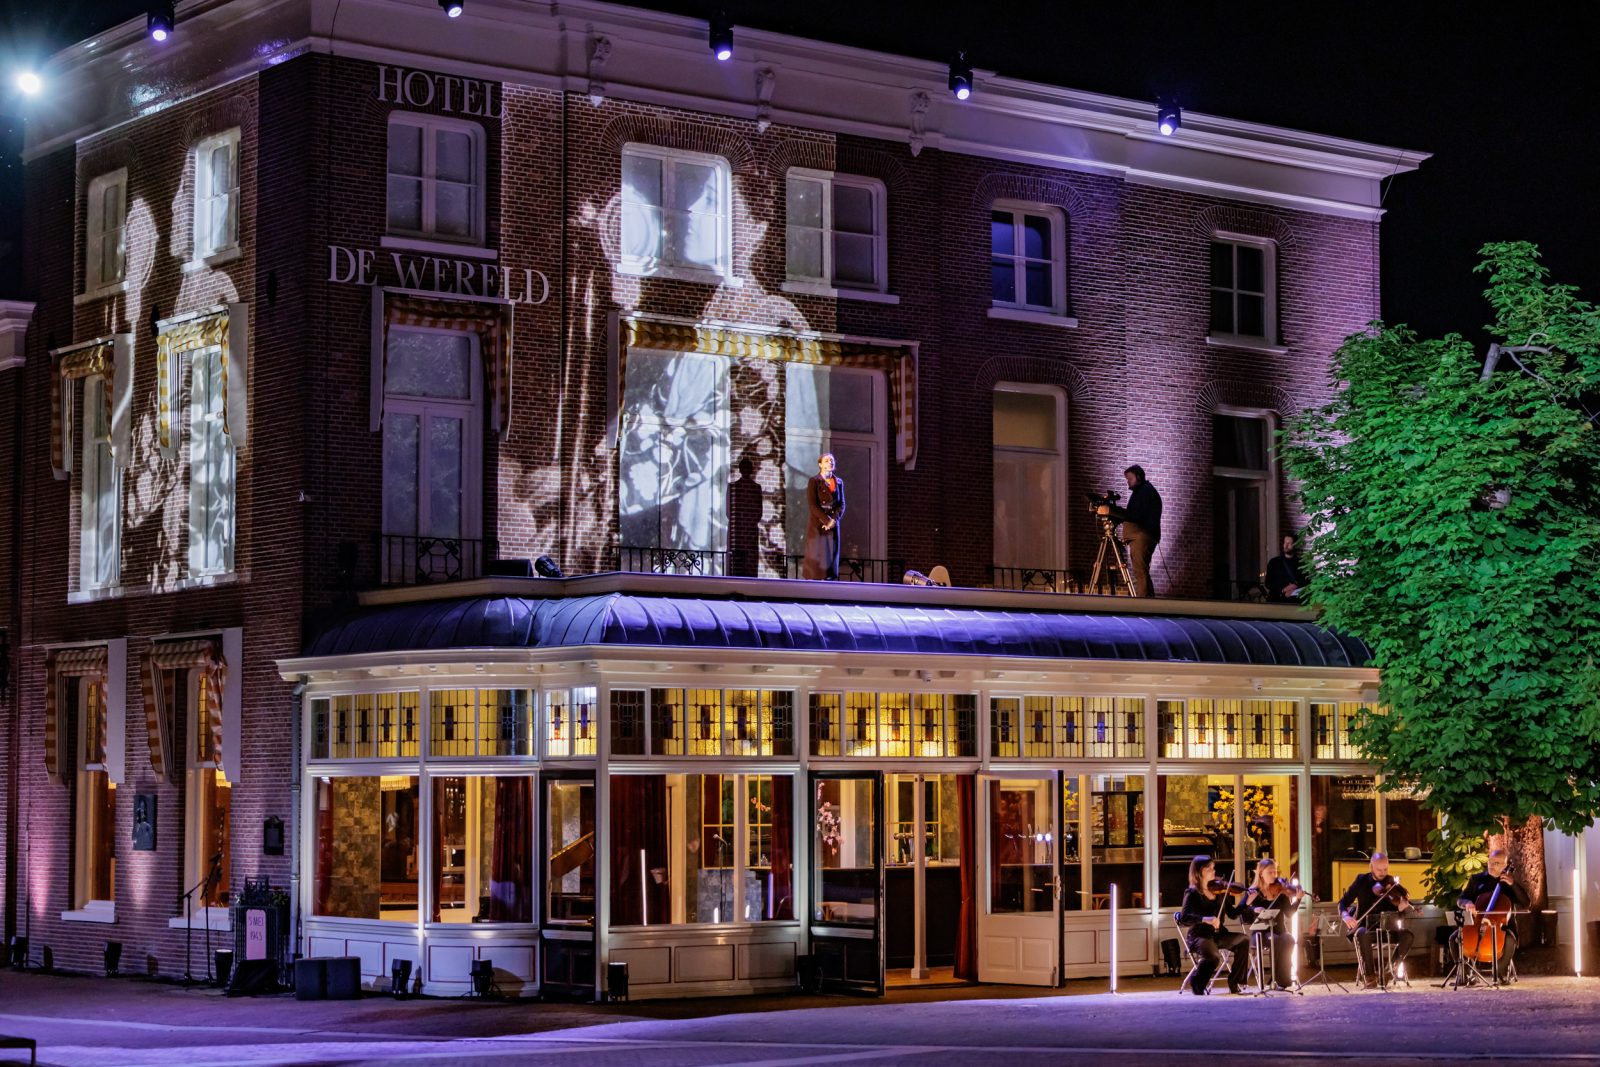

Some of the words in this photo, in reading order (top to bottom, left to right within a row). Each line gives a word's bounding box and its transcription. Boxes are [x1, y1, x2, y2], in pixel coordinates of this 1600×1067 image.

[376, 65, 504, 118] HOTEL
[328, 245, 378, 286] DE
[390, 252, 550, 305] WERELD
